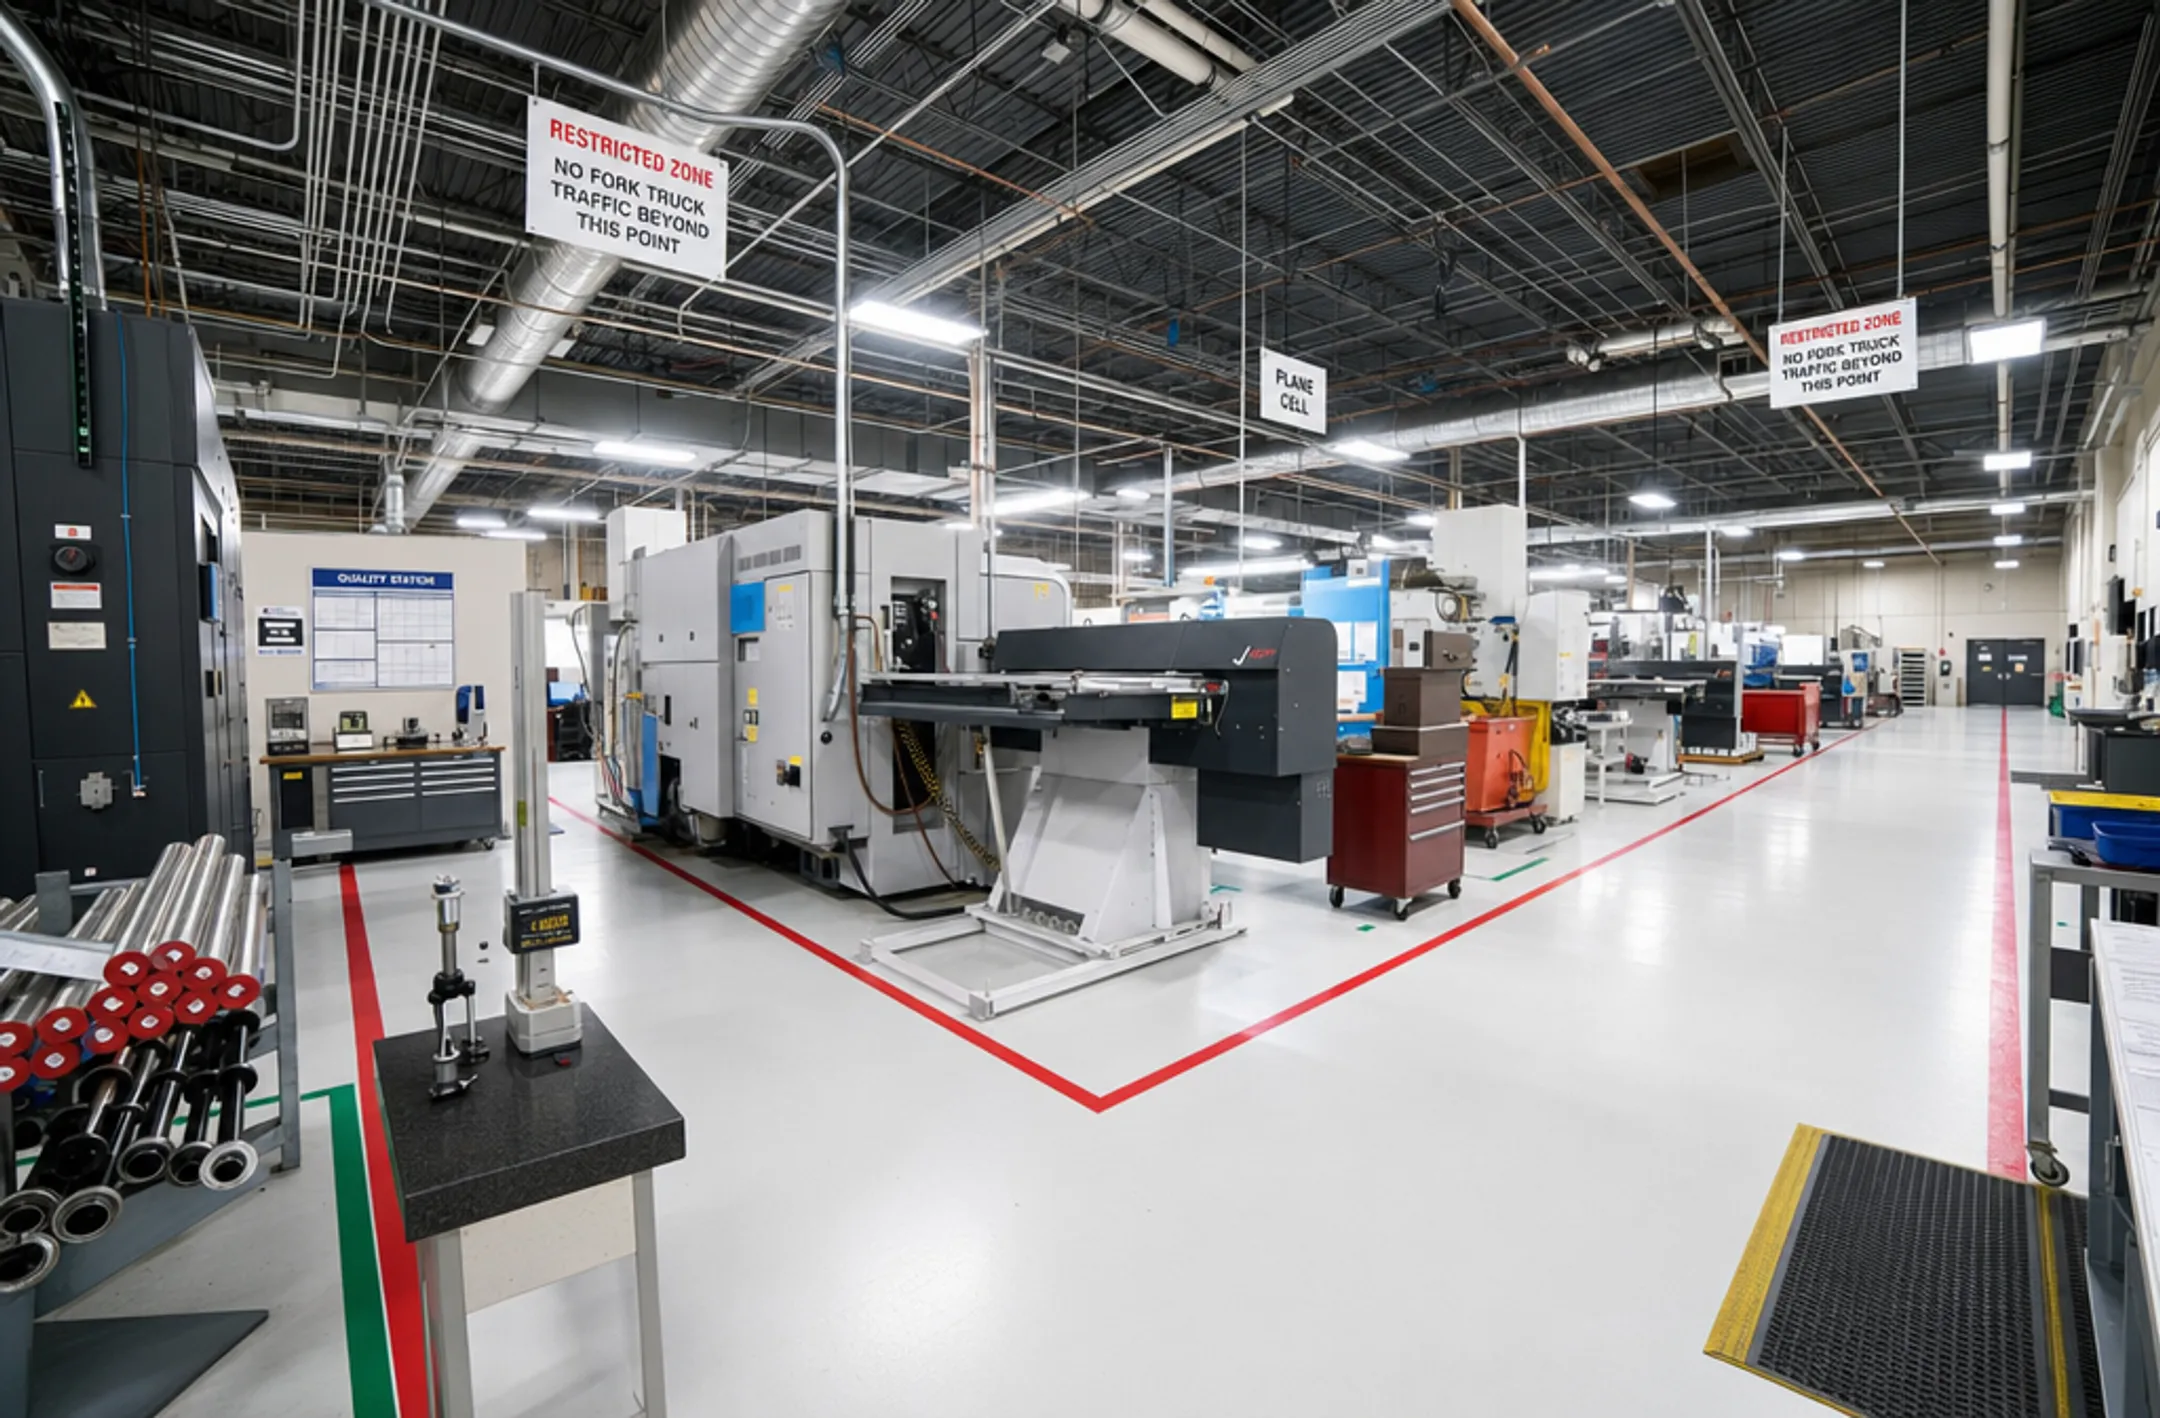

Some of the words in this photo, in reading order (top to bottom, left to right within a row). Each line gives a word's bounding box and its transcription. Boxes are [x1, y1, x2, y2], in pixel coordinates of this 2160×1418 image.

[550, 118, 664, 172] RESTRICTED
[670, 158, 714, 189] ZONE
[554, 157, 584, 179] NO
[590, 168, 641, 198] FORK
[647, 184, 706, 216] TRUCK
[551, 180, 631, 217] TRAFFIC
[638, 206, 710, 239] BEYOND
[576, 212, 621, 239] THIS
[627, 226, 681, 254] POINT
[1864, 310, 1902, 331] ZONE
[1783, 352, 1803, 364] NO
[1848, 334, 1900, 353] TRUCK
[1842, 350, 1902, 371] BEYOND
[1837, 370, 1882, 387] POINT
[337, 573, 387, 585] QUALITY
